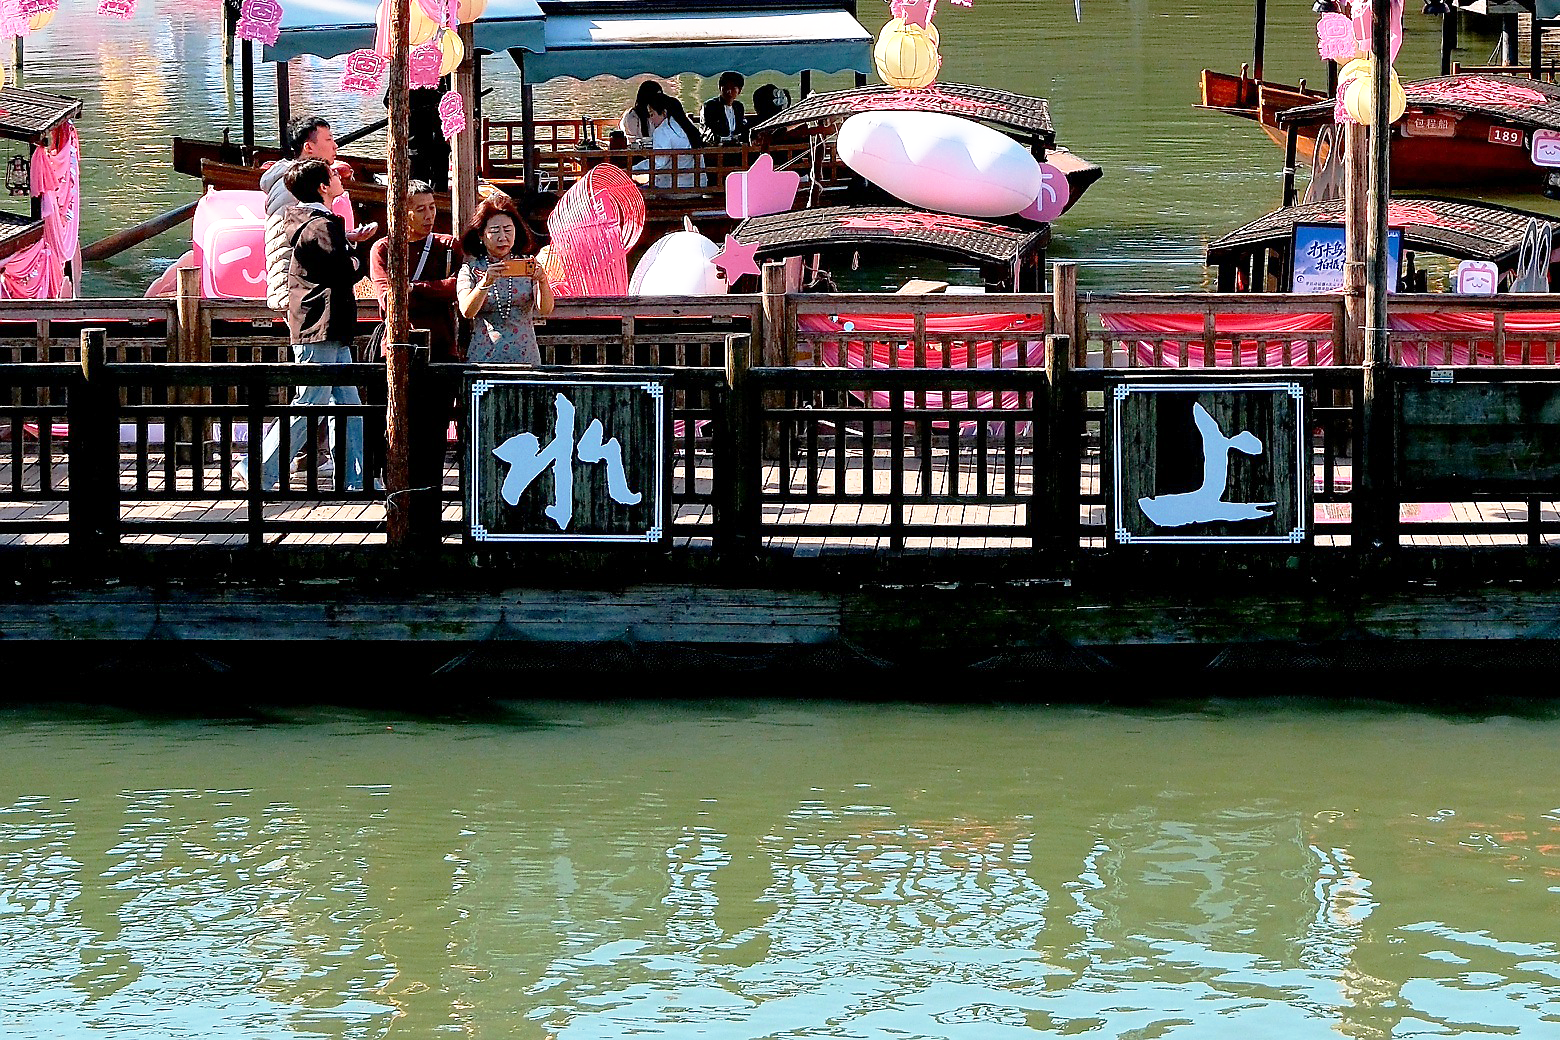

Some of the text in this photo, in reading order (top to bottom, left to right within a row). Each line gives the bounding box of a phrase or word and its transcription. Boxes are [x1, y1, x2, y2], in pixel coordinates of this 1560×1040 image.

[1494, 130, 1519, 143] 189
[1307, 241, 1346, 258] 打卡乌
[491, 392, 643, 530] 水
[1138, 401, 1277, 528] 上
